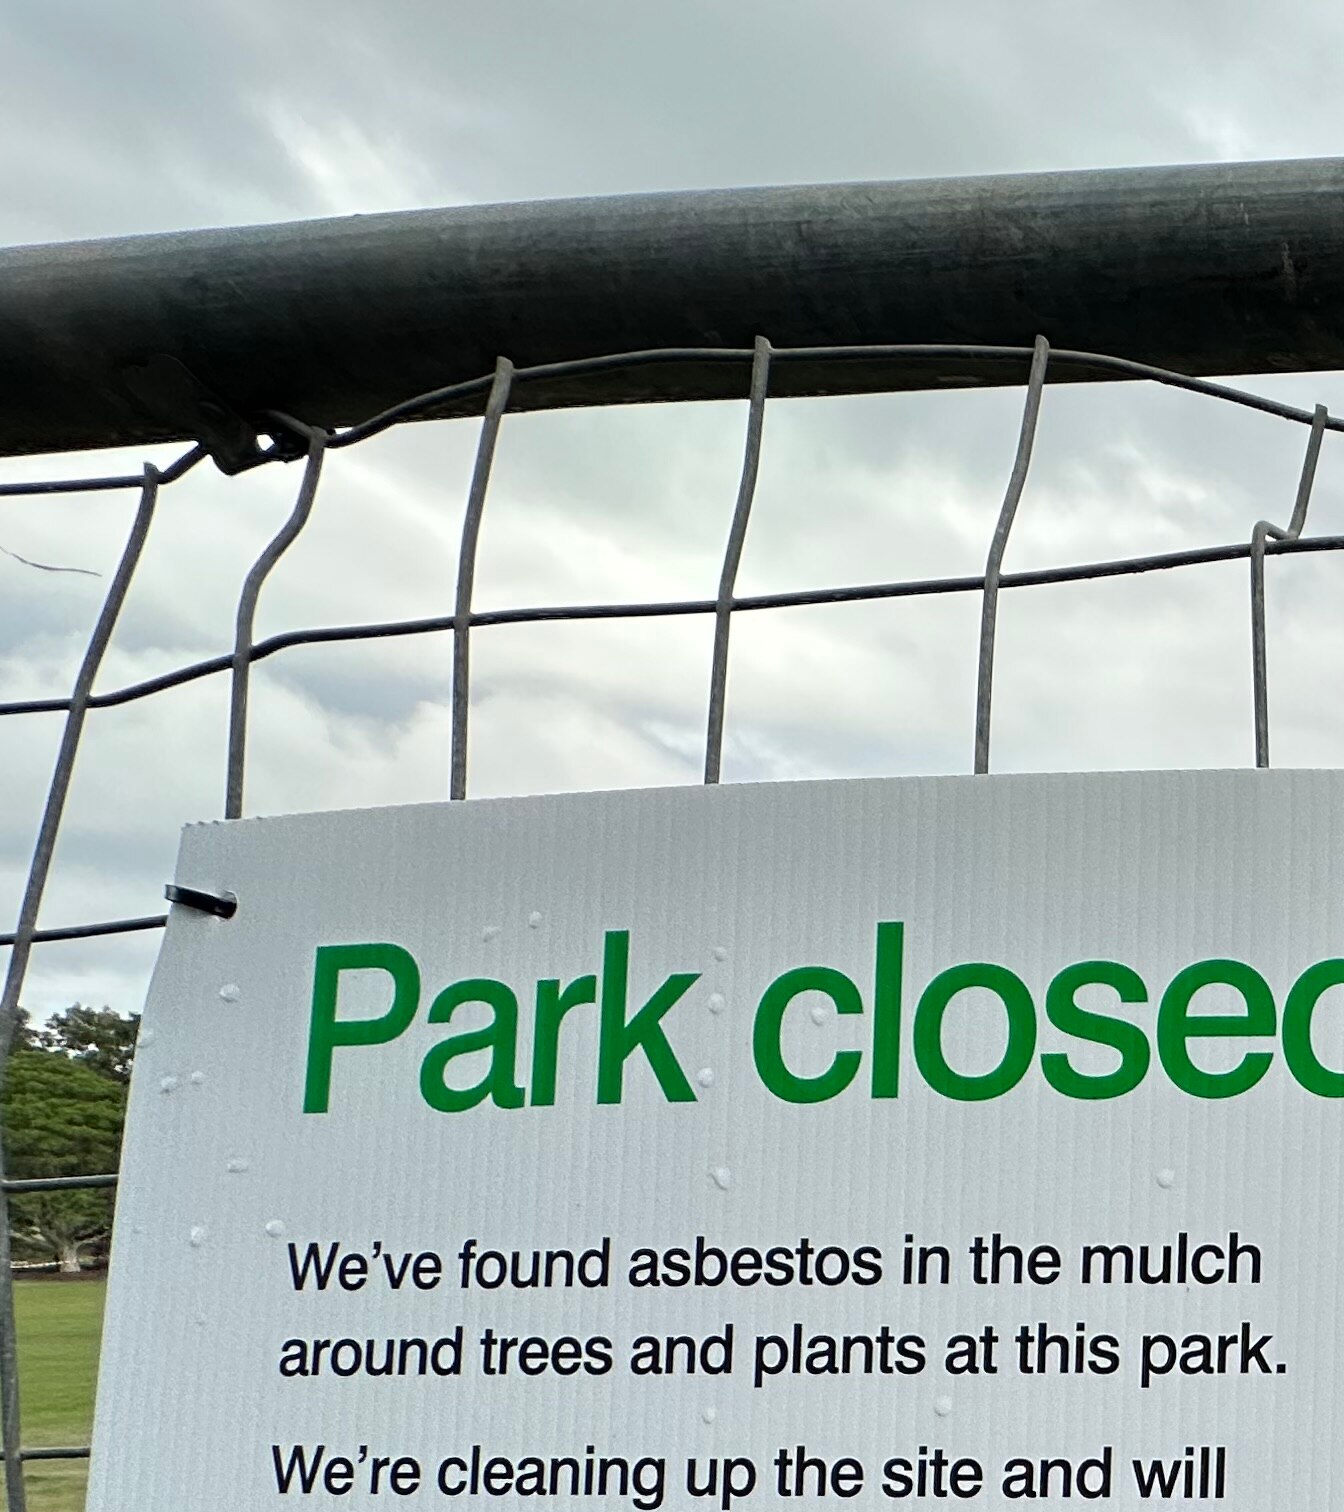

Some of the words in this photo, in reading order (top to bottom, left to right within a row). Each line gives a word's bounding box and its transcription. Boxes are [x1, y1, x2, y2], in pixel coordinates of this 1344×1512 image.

[302, 929, 701, 1115] Park
[287, 1240, 443, 1292] We’ve
[457, 1236, 611, 1290] found
[628, 1235, 883, 1288] asbestos
[902, 1233, 950, 1285] in
[968, 1232, 1062, 1286] the
[1081, 1231, 1262, 1285] mulch
[279, 1325, 464, 1378] around
[479, 1328, 613, 1376] trees
[630, 1323, 734, 1376] and
[753, 1322, 927, 1389] plants
[944, 1325, 999, 1375] at
[1014, 1321, 1120, 1375] this
[1140, 1321, 1287, 1389] park.
[271, 1444, 421, 1496] We’re
[437, 1444, 666, 1511] cleaning
[686, 1457, 757, 1511] up
[773, 1445, 864, 1498] the
[881, 1445, 984, 1499] site
[1001, 1446, 1113, 1500] and
[1131, 1446, 1226, 1499] will
